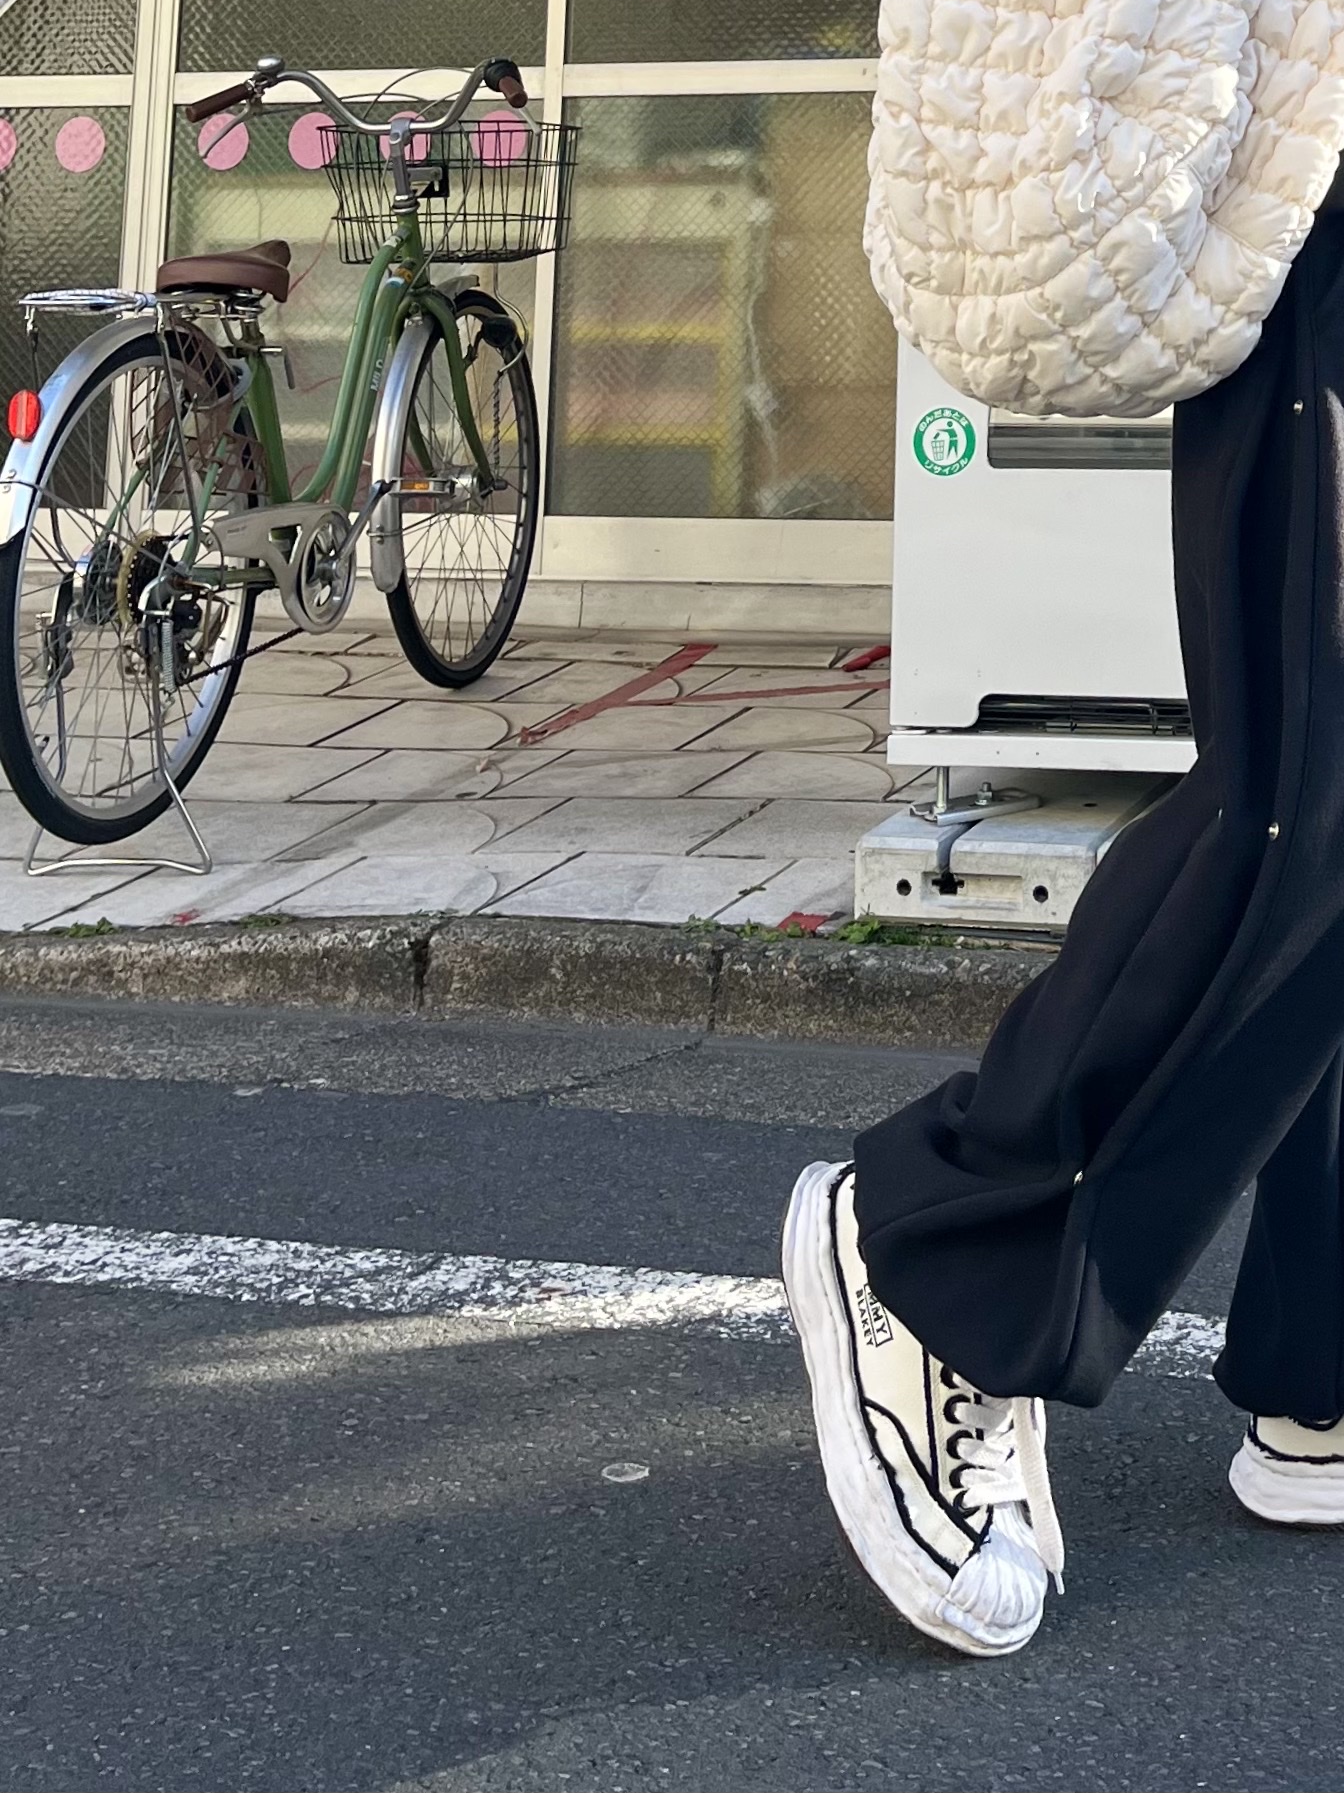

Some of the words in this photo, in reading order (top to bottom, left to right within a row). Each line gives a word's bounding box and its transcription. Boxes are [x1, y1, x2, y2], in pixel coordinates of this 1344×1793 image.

[918, 409, 969, 432] のんだあとは
[924, 457, 969, 475] リサイクル
[855, 1288, 874, 1346] BLAKEY
